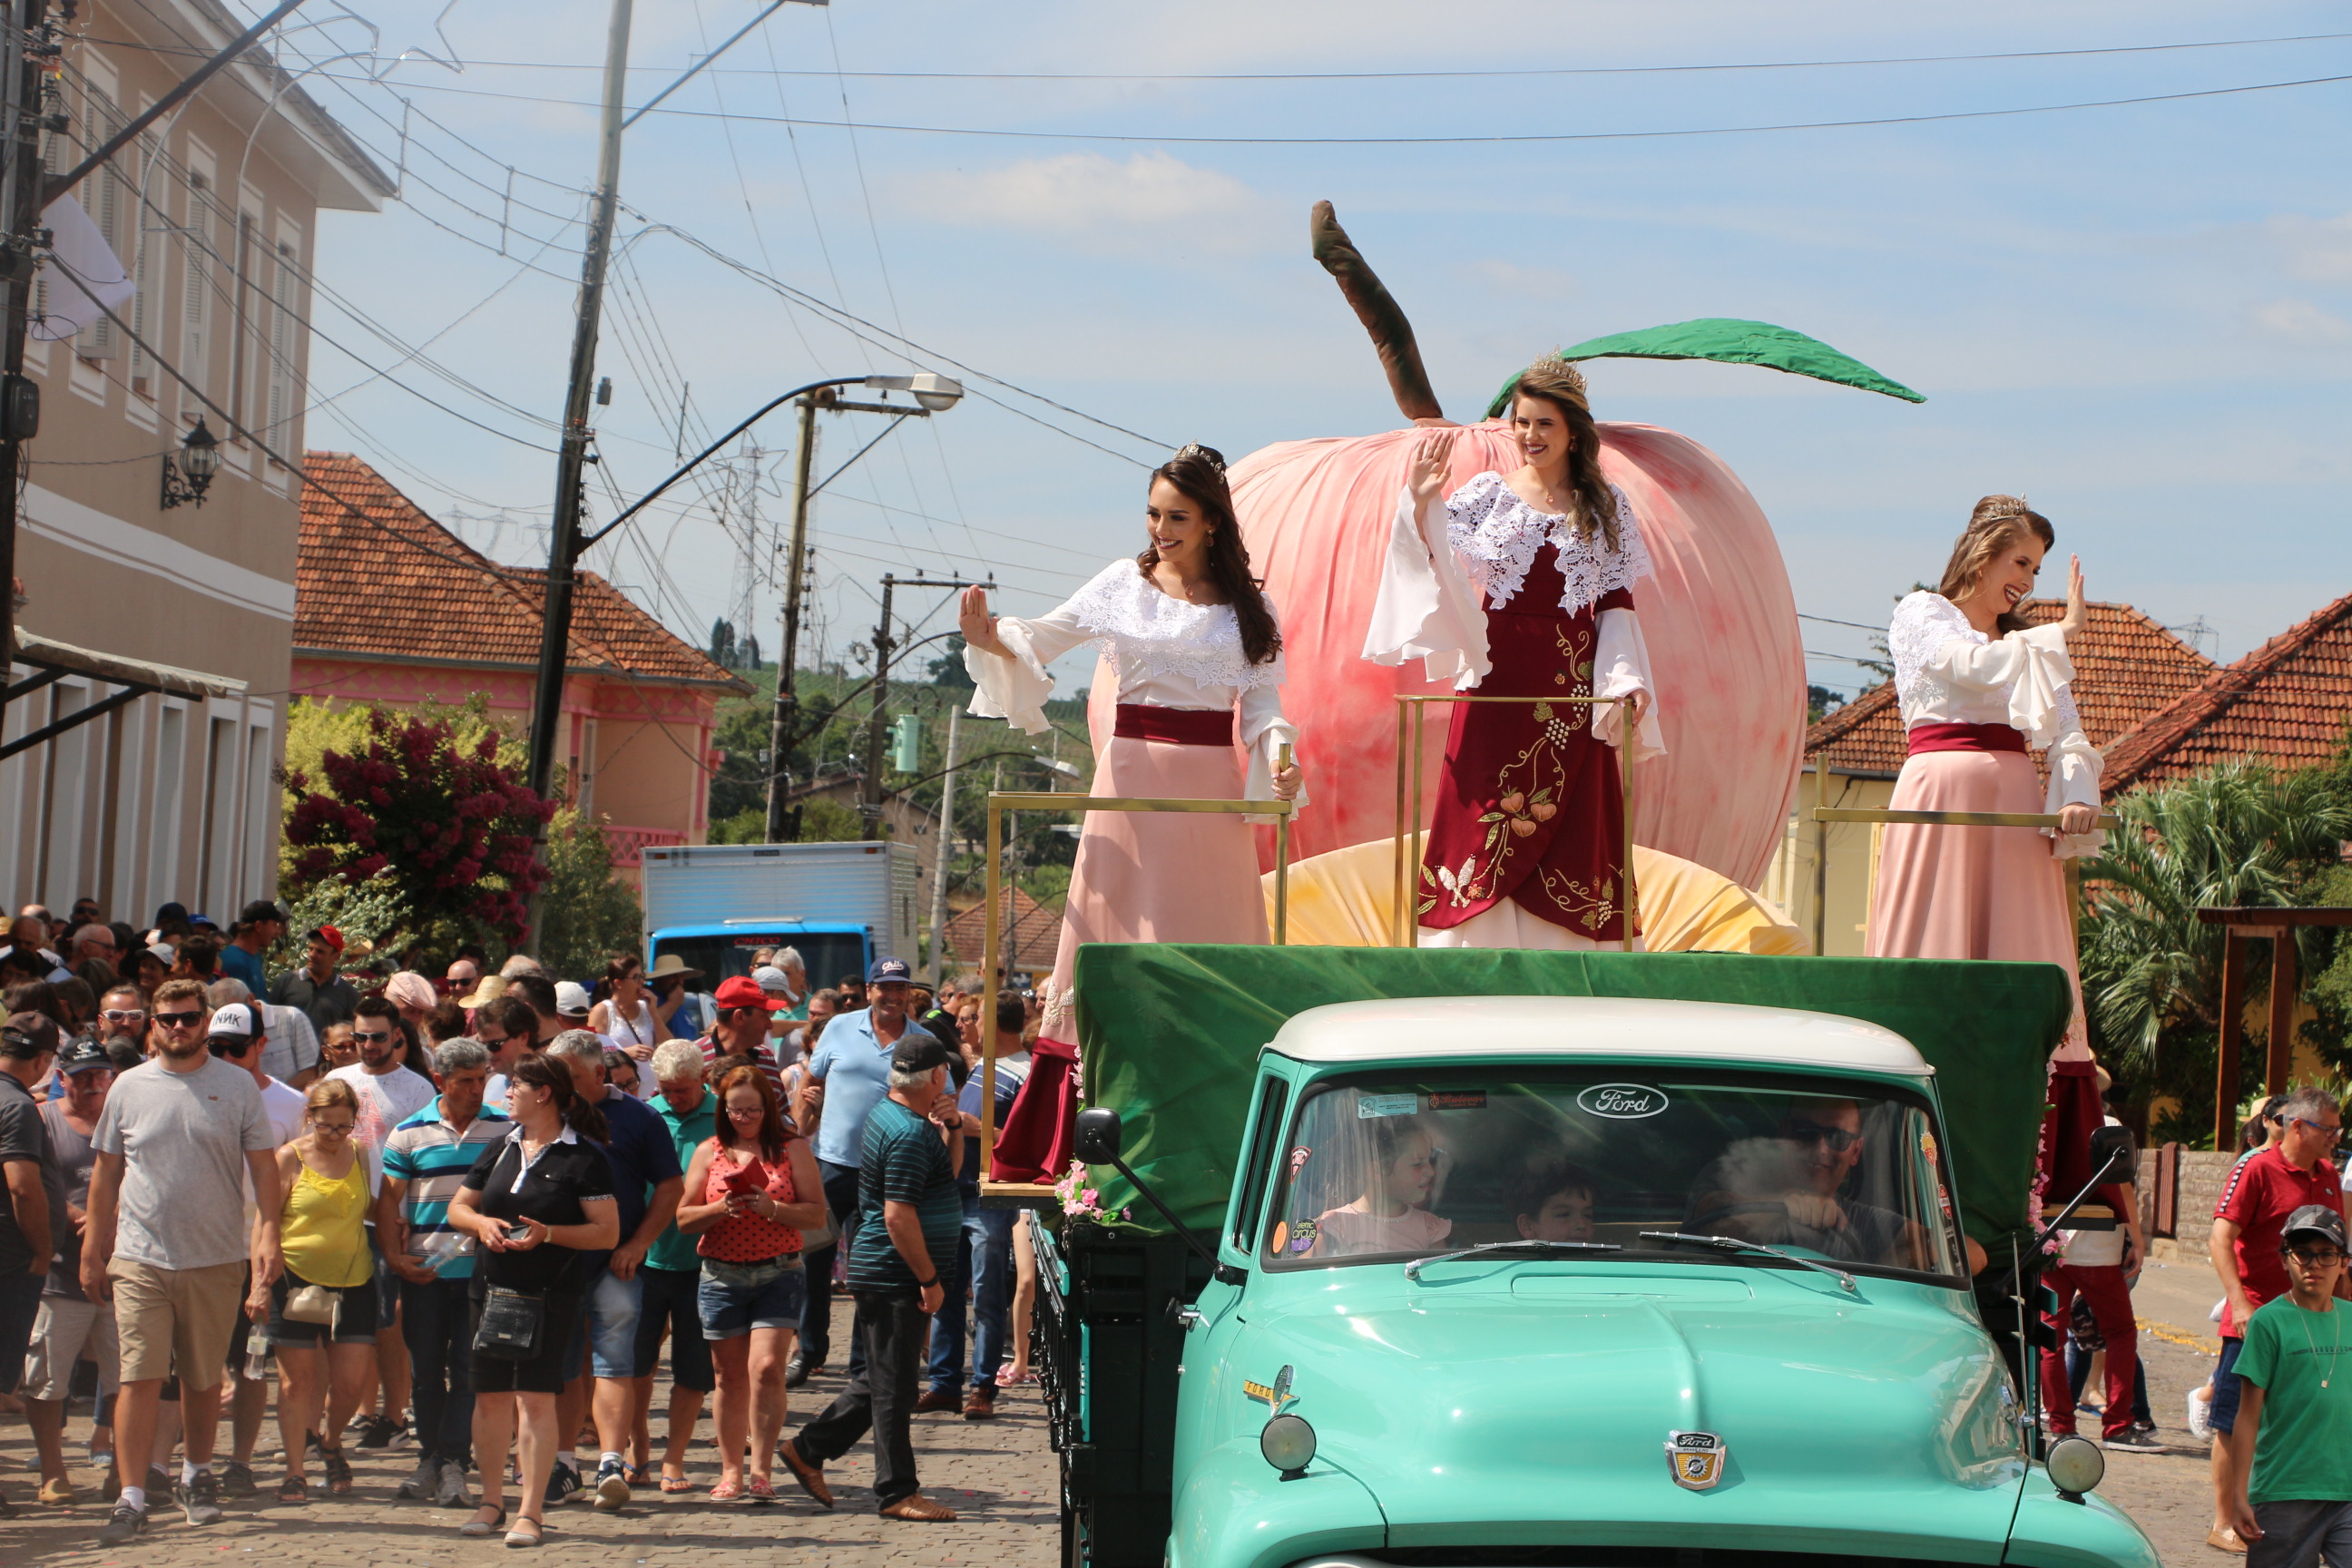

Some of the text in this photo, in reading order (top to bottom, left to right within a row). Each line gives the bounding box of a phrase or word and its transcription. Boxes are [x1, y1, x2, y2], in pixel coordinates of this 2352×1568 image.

[733, 936, 781, 946] CHICO
[1595, 1089, 1650, 1112] Ford
[1247, 1382, 1270, 1397] FORD
[1679, 1436, 1712, 1446] Ford
